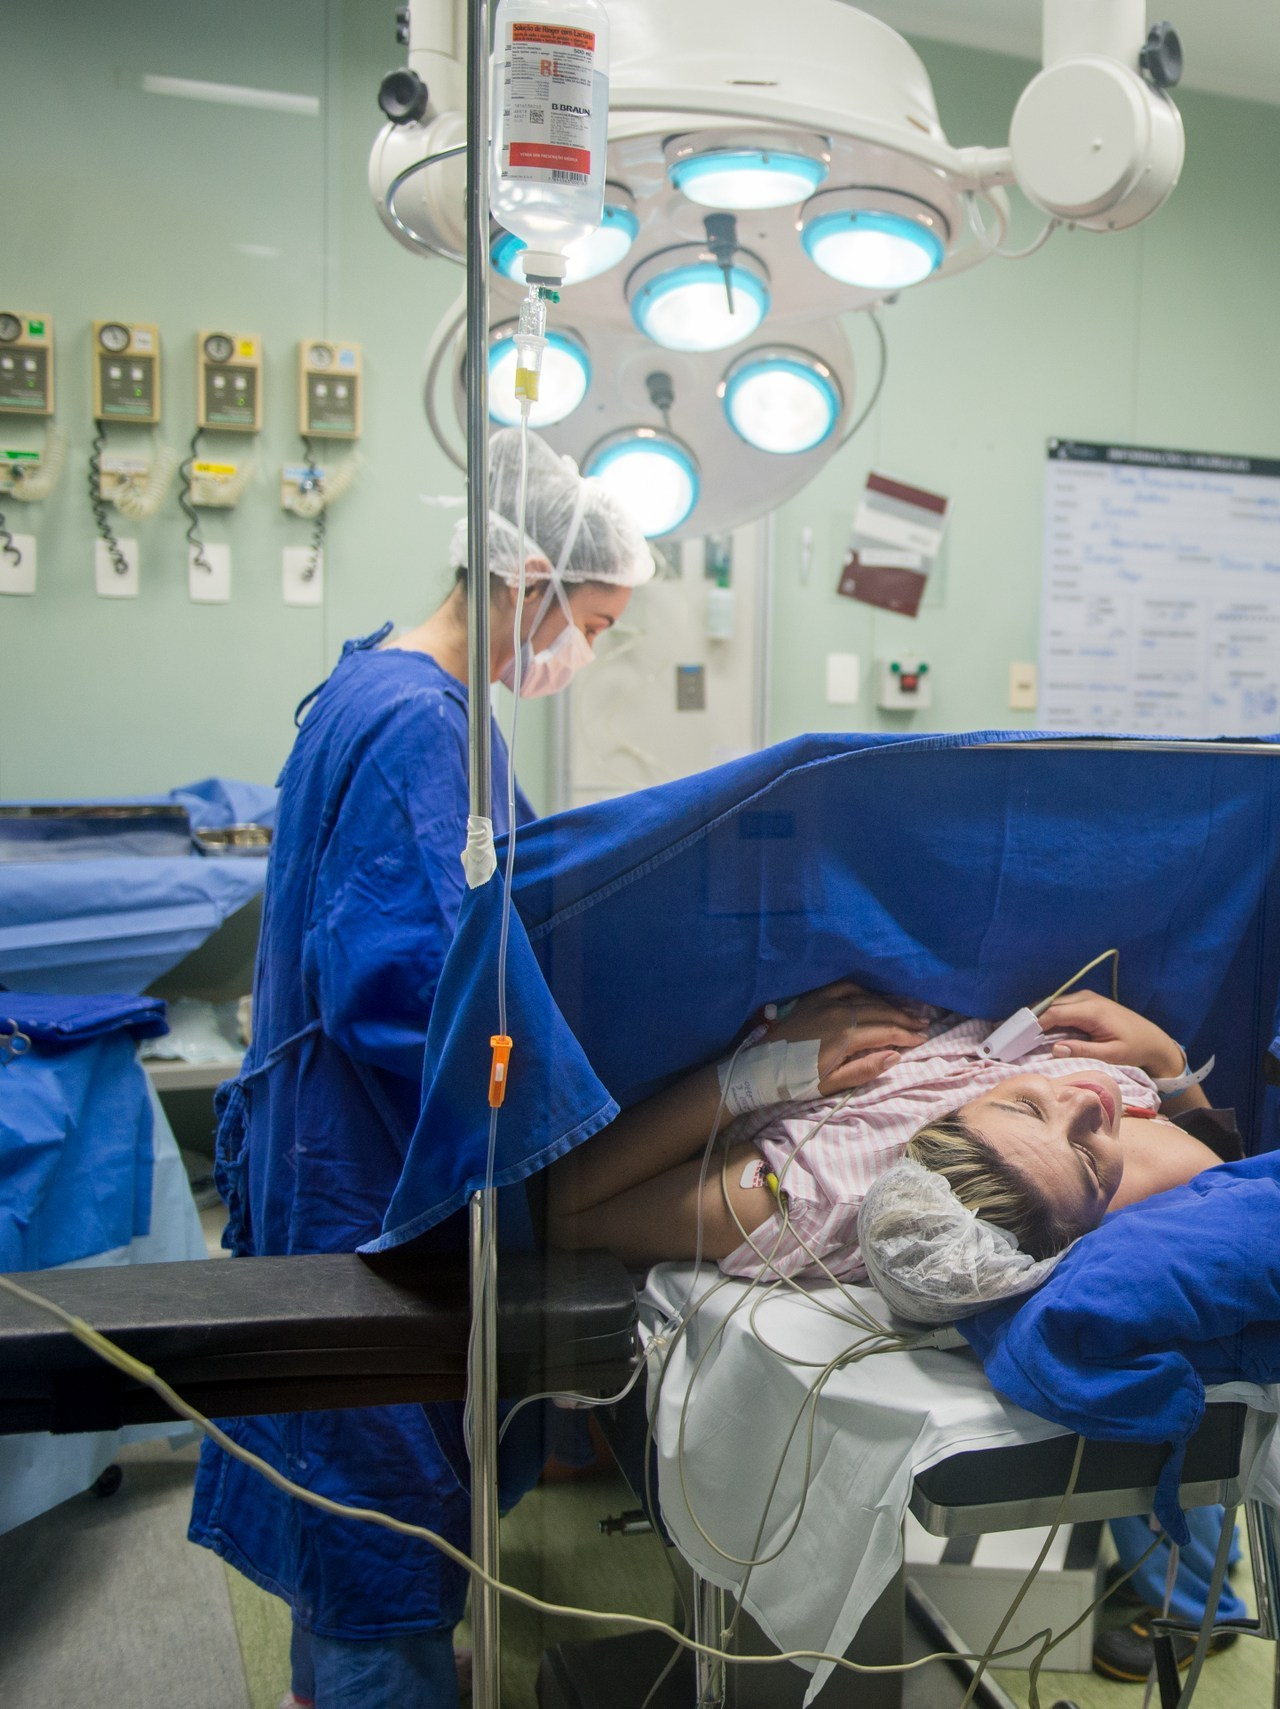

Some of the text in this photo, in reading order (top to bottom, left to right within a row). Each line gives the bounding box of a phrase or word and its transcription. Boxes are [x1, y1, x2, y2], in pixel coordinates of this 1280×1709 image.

[513, 24, 534, 32] Solução
[543, 25, 560, 36] Ringer
[560, 104, 590, 115] BRAUN
